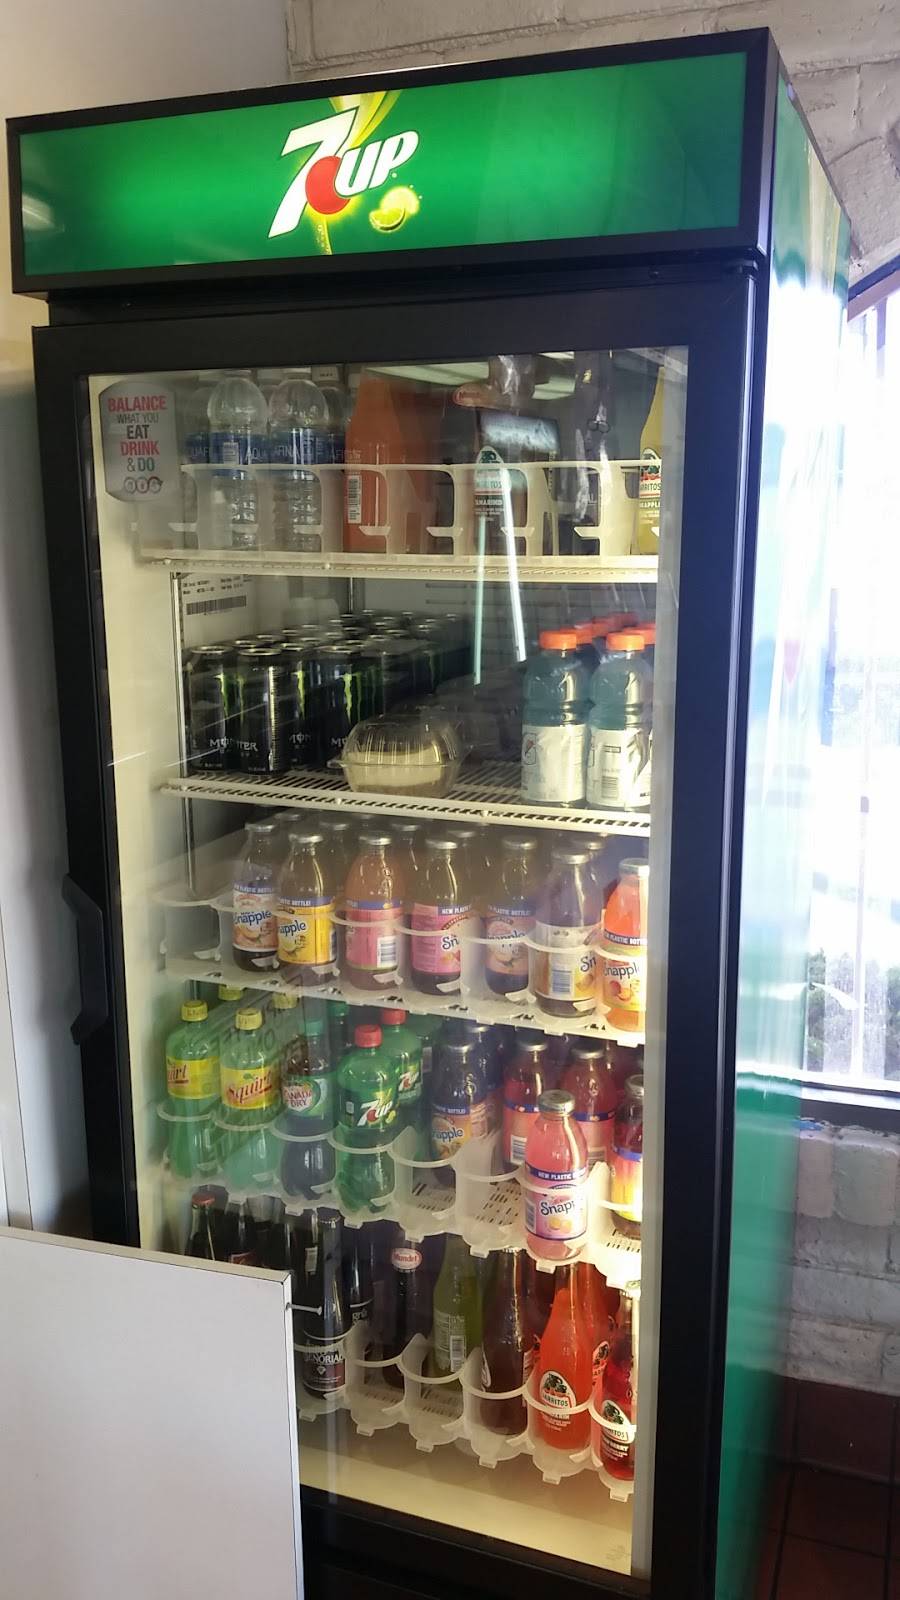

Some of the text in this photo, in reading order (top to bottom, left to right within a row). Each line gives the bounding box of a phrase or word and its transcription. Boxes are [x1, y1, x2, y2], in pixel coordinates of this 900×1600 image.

[108, 396, 167, 412] BALANCE
[117, 412, 159, 424] WHAT YOU
[127, 425, 149, 440] EAT
[121, 441, 160, 456] DRINK
[127, 457, 155, 472] & DO
[280, 920, 306, 936] apple
[228, 1071, 273, 1104] Squirt
